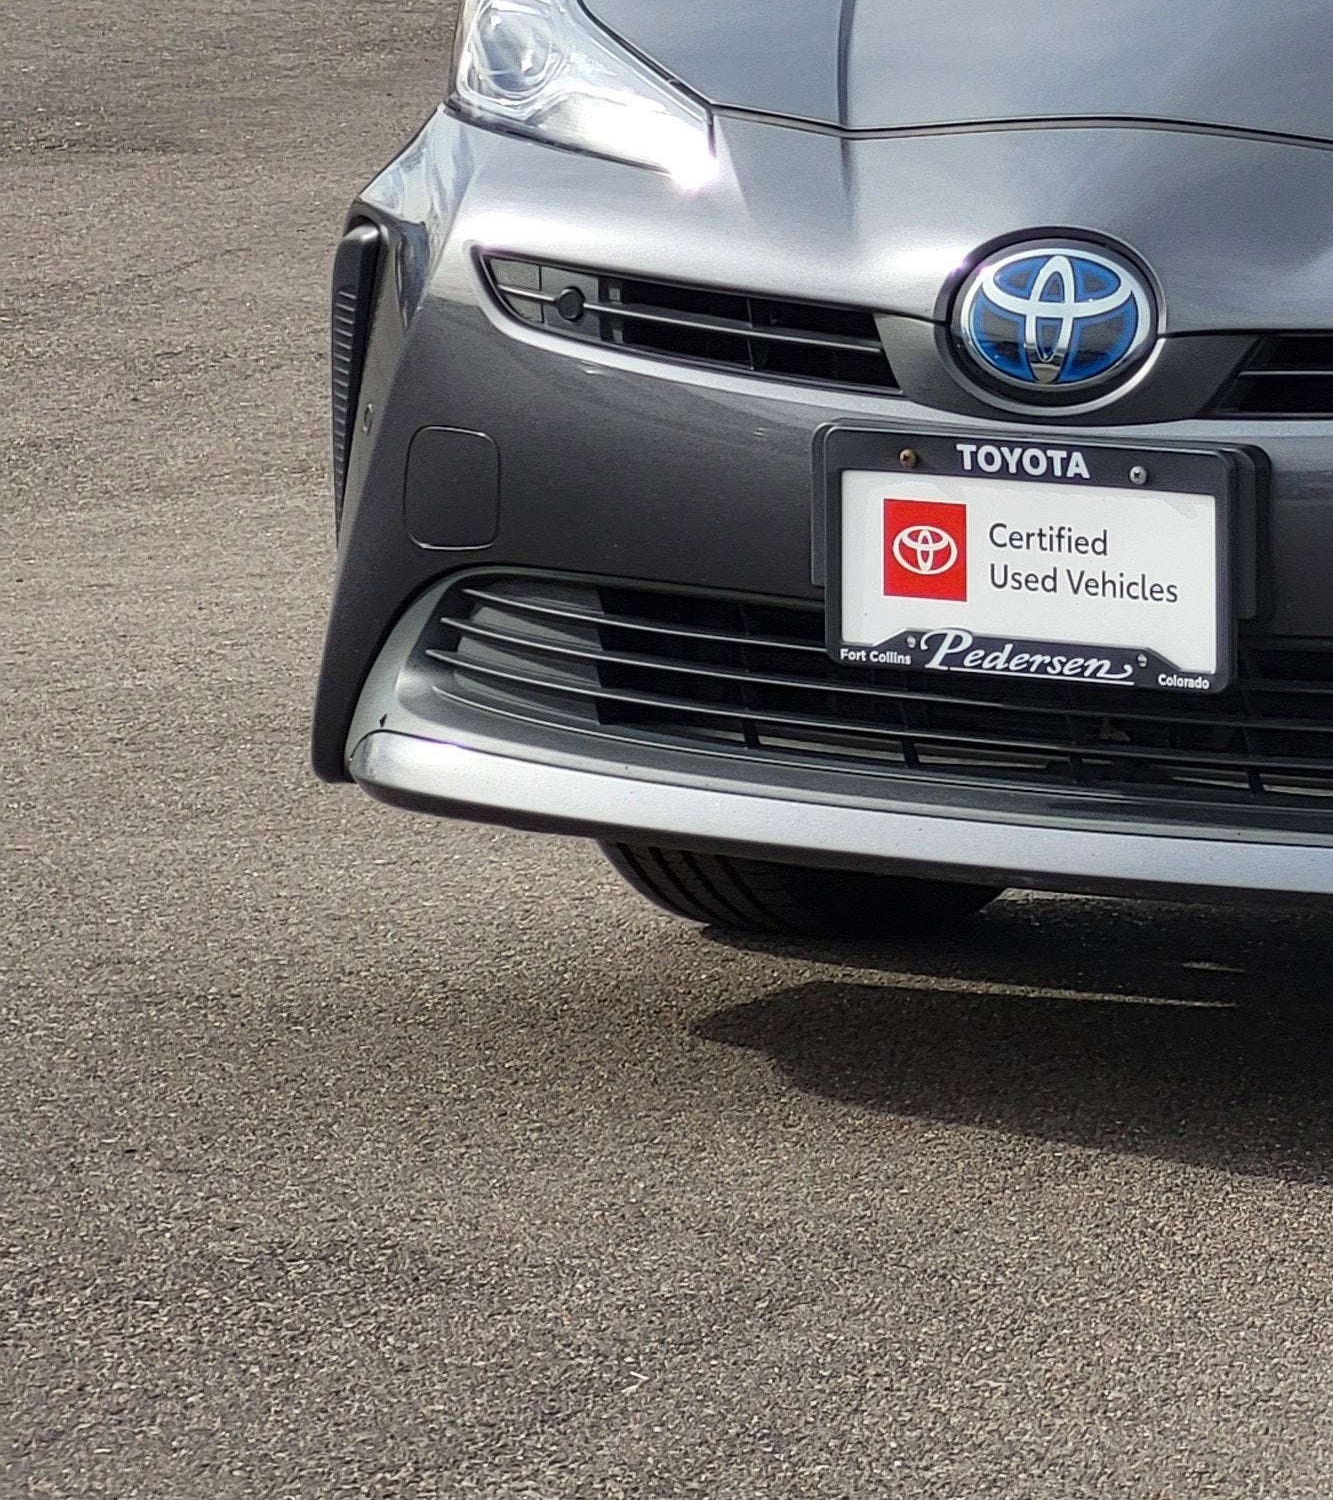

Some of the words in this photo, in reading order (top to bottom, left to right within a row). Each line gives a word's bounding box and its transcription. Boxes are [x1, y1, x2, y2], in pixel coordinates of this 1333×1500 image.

[956, 443, 1090, 479] TOYOTA
[989, 522, 1108, 556] Certified
[990, 563, 1058, 593] Used
[1066, 568, 1178, 603] Vehicles
[840, 648, 867, 663] Fort
[869, 650, 912, 666] Collins
[920, 628, 1134, 680] Pedersen
[1158, 673, 1211, 690] Colorado
